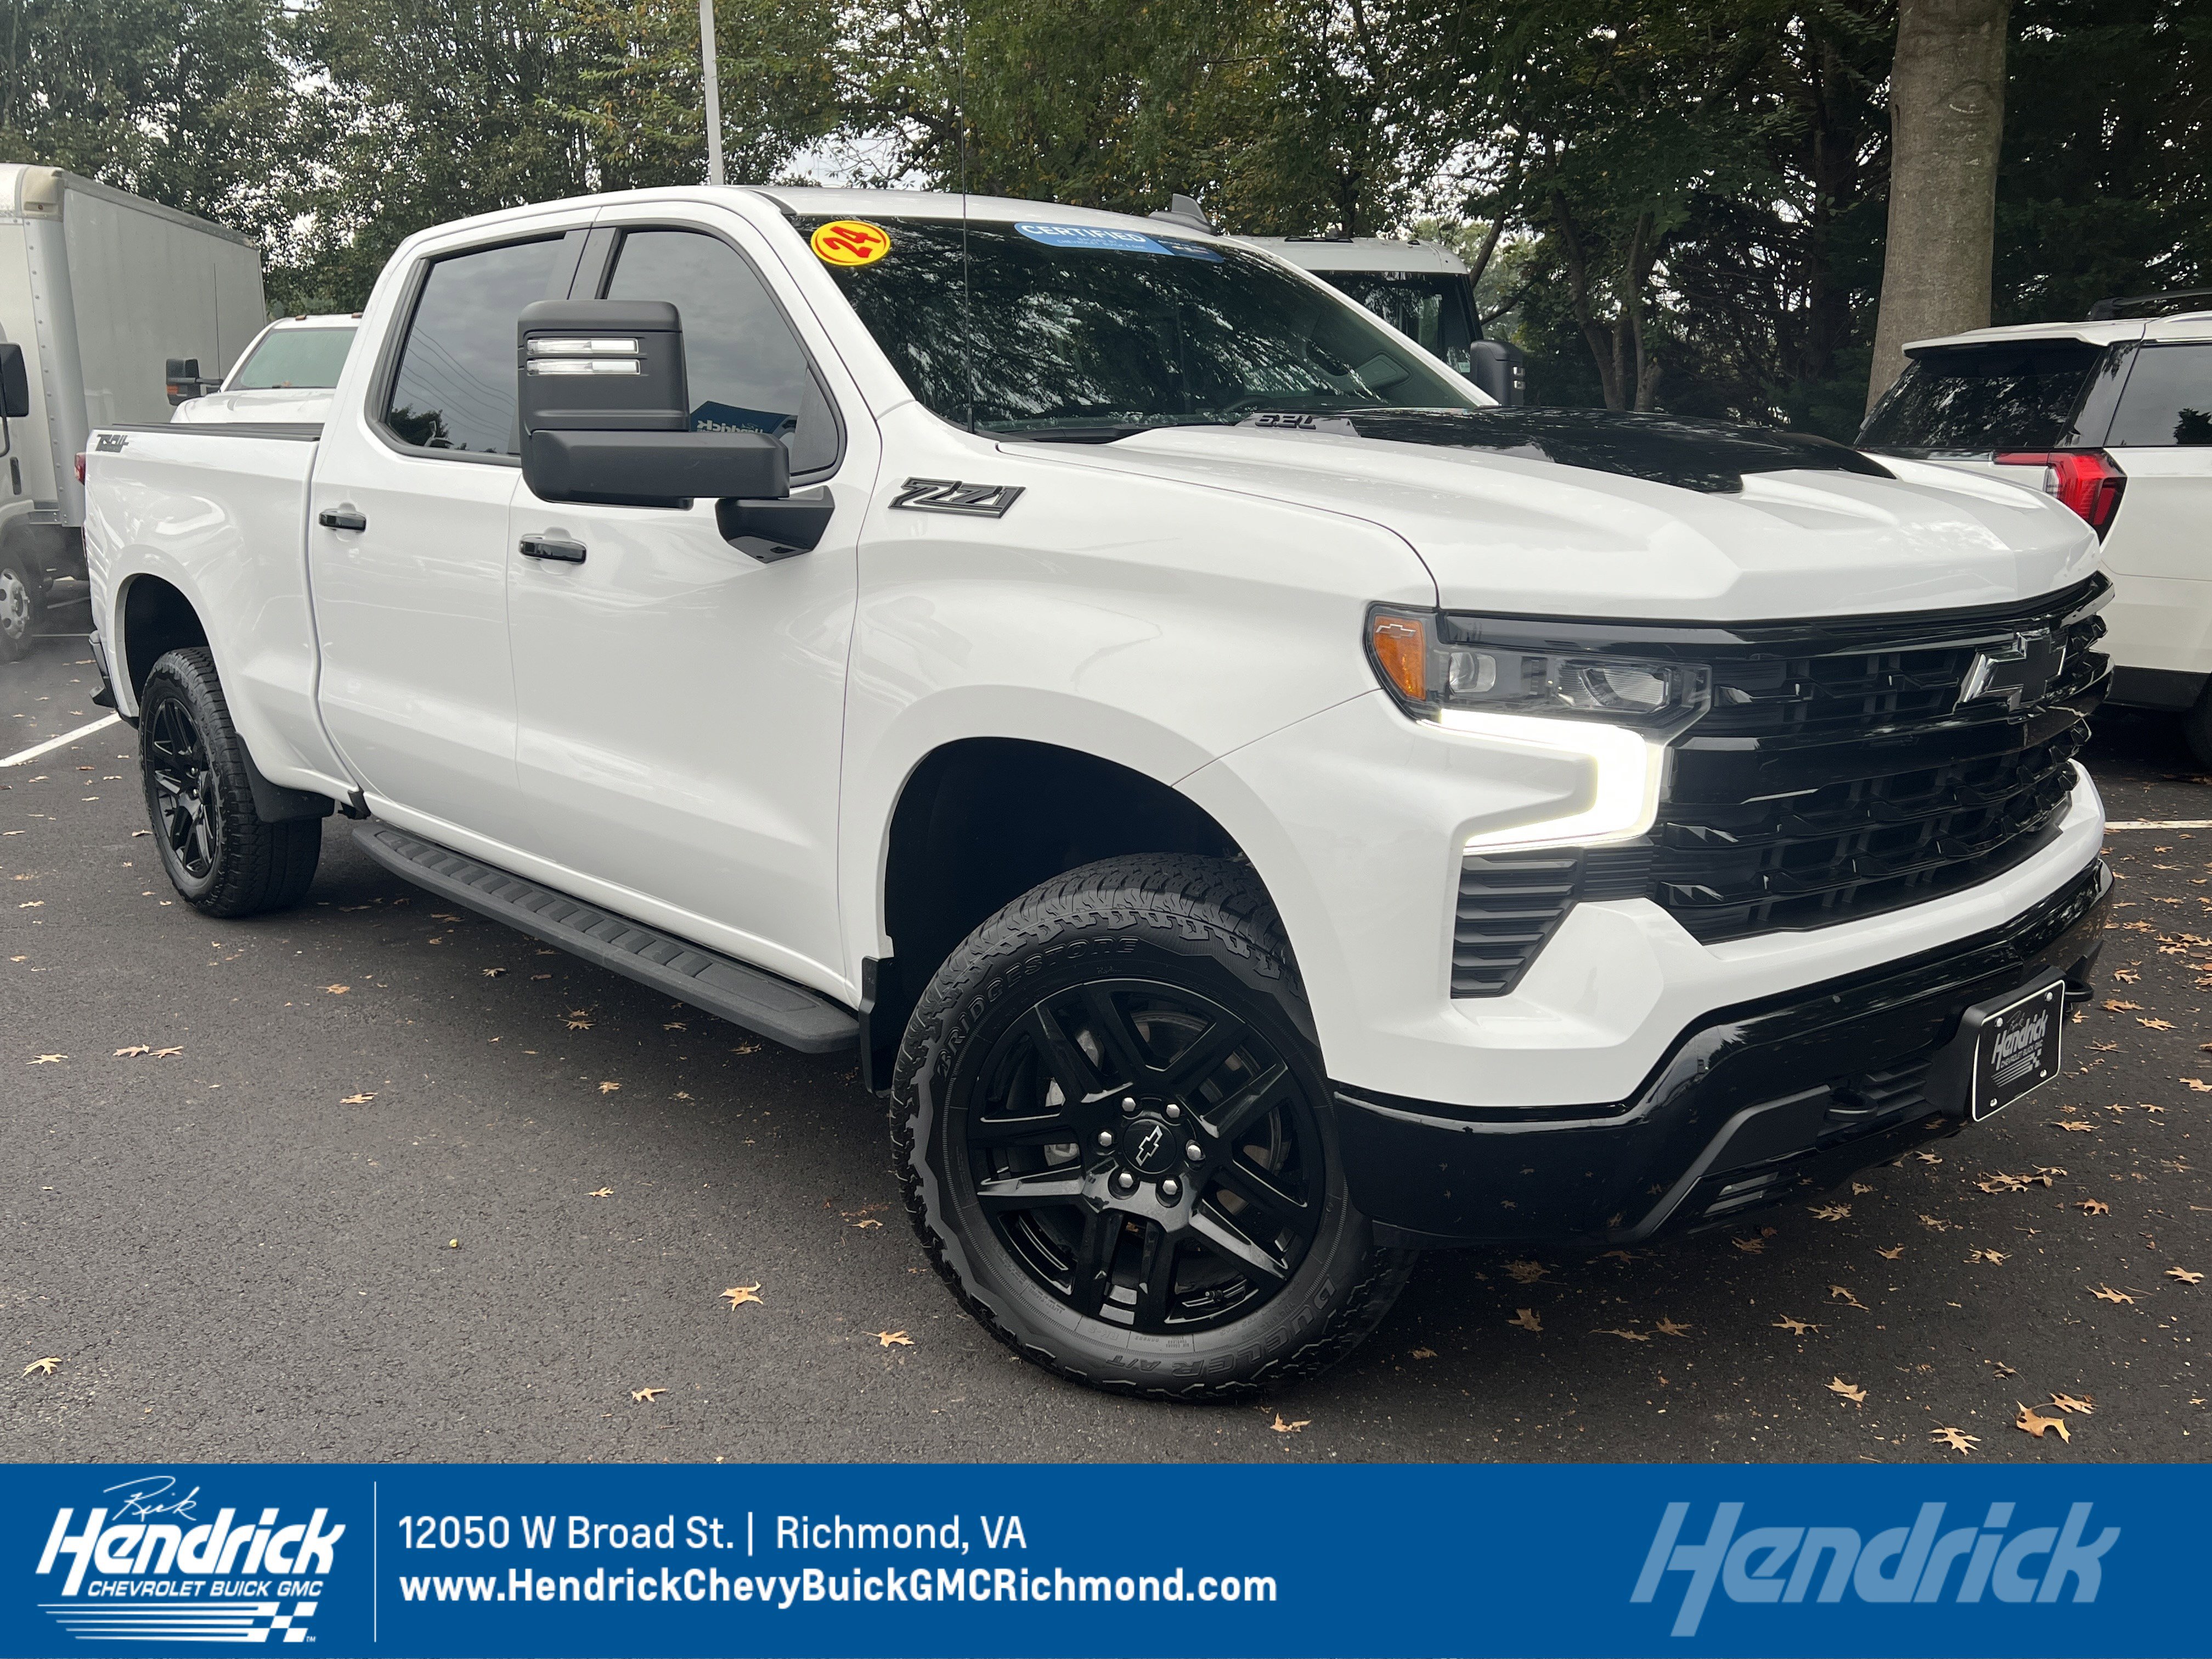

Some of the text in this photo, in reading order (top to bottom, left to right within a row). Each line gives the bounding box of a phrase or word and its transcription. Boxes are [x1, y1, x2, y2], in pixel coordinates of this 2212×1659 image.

[823, 226, 881, 258] 24
[1021, 224, 1146, 243] CERTIFIED
[888, 477, 1026, 518] Z71
[934, 935, 1141, 1081] BRIDGESTONE
[1991, 1009, 2049, 1071] Hendrick
[1172, 1277, 1338, 1378] DUELER
[1105, 1355, 1162, 1372] A/T
